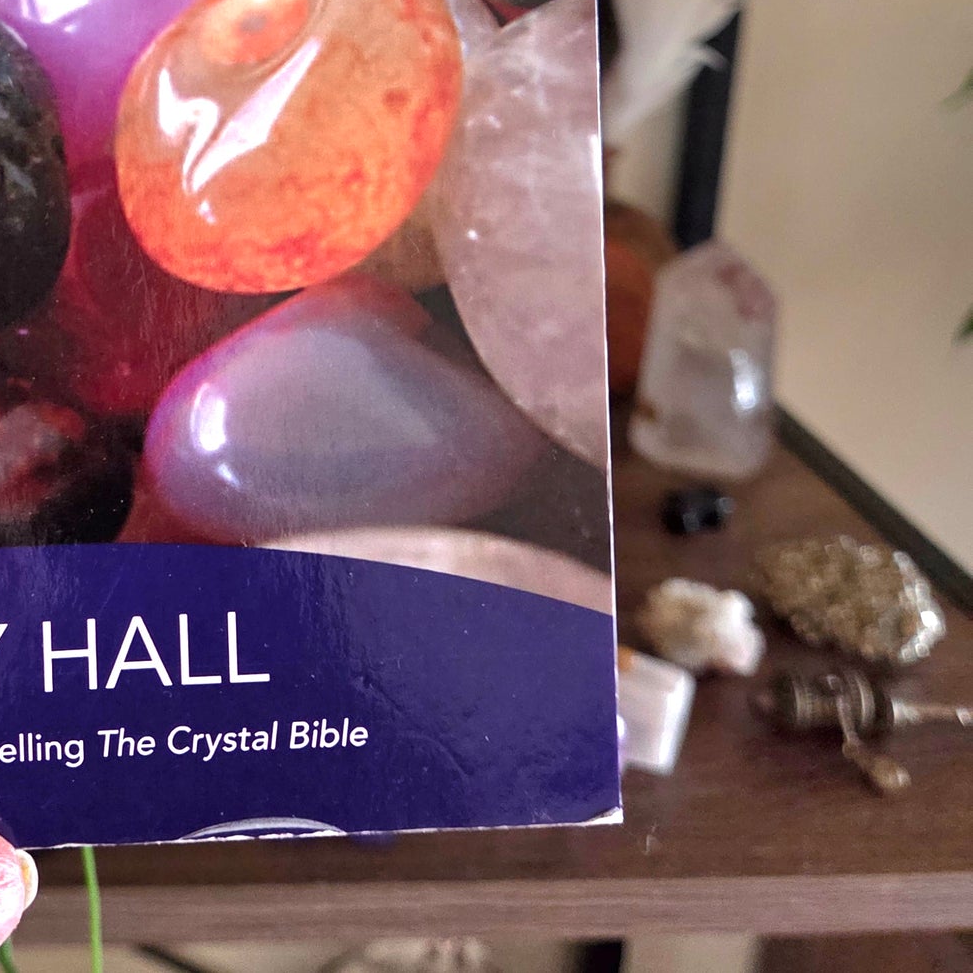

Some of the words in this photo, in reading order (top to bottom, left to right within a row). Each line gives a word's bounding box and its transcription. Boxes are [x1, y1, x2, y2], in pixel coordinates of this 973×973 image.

[42, 611, 271, 693] HALL
[97, 727, 156, 758] The
[167, 720, 279, 762] Crystal
[289, 717, 369, 750] Bible
